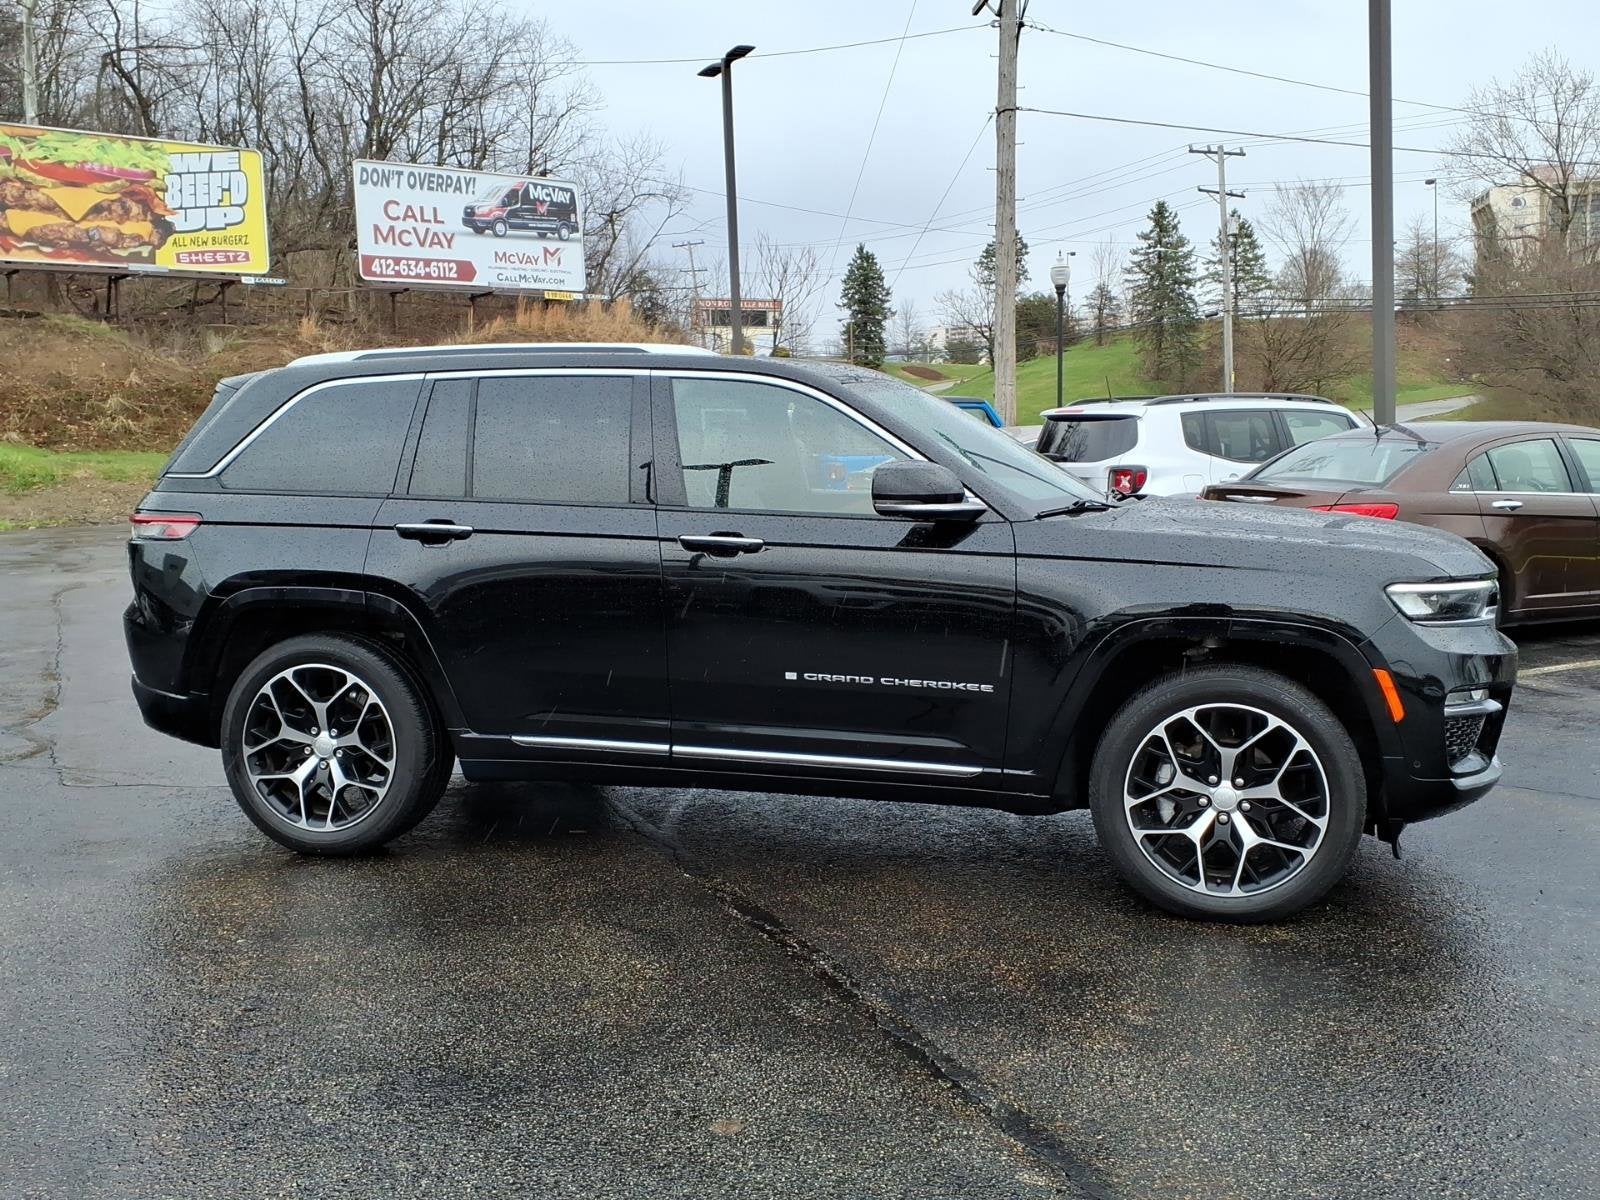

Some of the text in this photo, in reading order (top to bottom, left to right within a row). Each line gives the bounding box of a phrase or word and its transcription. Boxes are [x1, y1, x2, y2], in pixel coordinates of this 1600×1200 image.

[168, 150, 240, 172] WE
[164, 171, 247, 208] BEEF'D
[359, 166, 477, 195] DON'T OVERPAY!
[165, 206, 245, 231] UP
[383, 199, 445, 224] CALL
[172, 234, 250, 247] ALL NEW BURGERZ
[179, 251, 247, 263] SHEETZ
[371, 258, 458, 278] 412-634-6112
[803, 672, 995, 693] GRAND CHEROKEE
